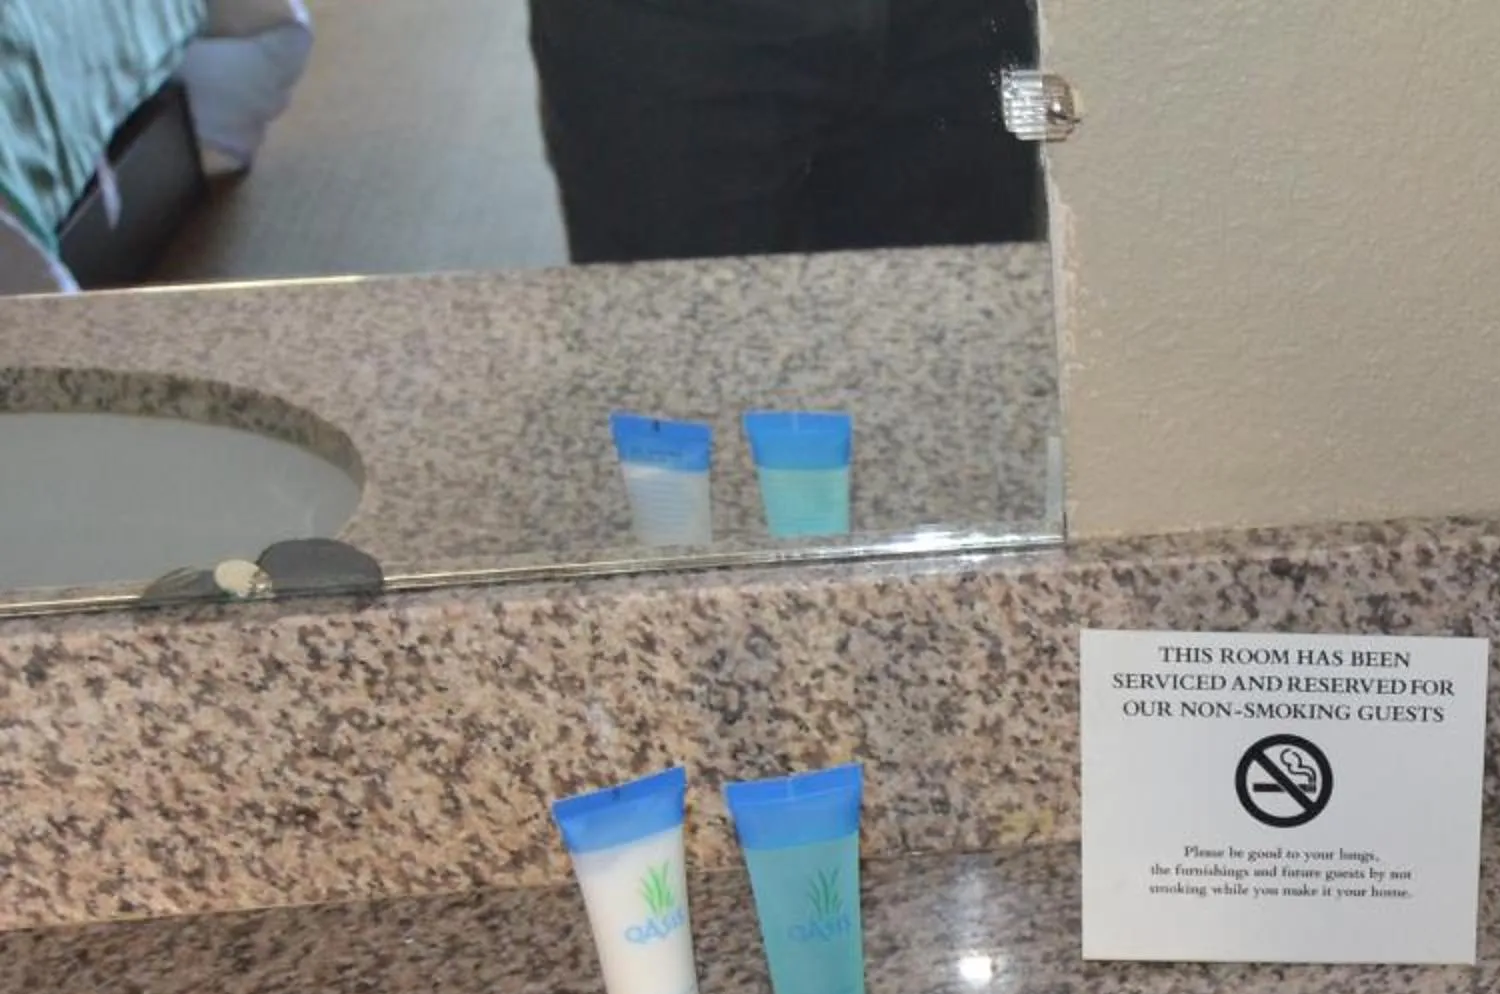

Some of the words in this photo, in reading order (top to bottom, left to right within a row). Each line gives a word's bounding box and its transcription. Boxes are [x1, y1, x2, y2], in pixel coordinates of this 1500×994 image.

[1158, 645, 1213, 664] THIS
[1220, 647, 1289, 665] ROOM
[1297, 649, 1344, 667] HAS
[1351, 651, 1411, 668] BEEN
[1112, 672, 1227, 691] SERVICED
[1231, 675, 1283, 692] AND
[1287, 676, 1407, 695] RESERVED
[1411, 679, 1455, 697] FOR
[1123, 700, 1172, 717] OUR
[1180, 701, 1350, 720] NON-SMOKING
[1357, 704, 1444, 723] GUESTS
[1184, 845, 1224, 859] Please
[1228, 846, 1245, 859] be
[1247, 848, 1282, 863] good
[1286, 849, 1301, 860] to
[1302, 851, 1334, 864] your
[1151, 863, 1171, 876] the
[1175, 863, 1249, 881] furnishings
[1253, 864, 1277, 877] and
[1281, 866, 1321, 879] future
[1325, 868, 1365, 881] guests
[1369, 866, 1384, 882] by
[1389, 870, 1411, 880] not
[1149, 881, 1206, 898] smoking
[1211, 882, 1248, 896] while
[1253, 886, 1278, 899] you
[1283, 883, 1318, 897] make
[1322, 884, 1332, 897] it
[1336, 887, 1368, 900] your
